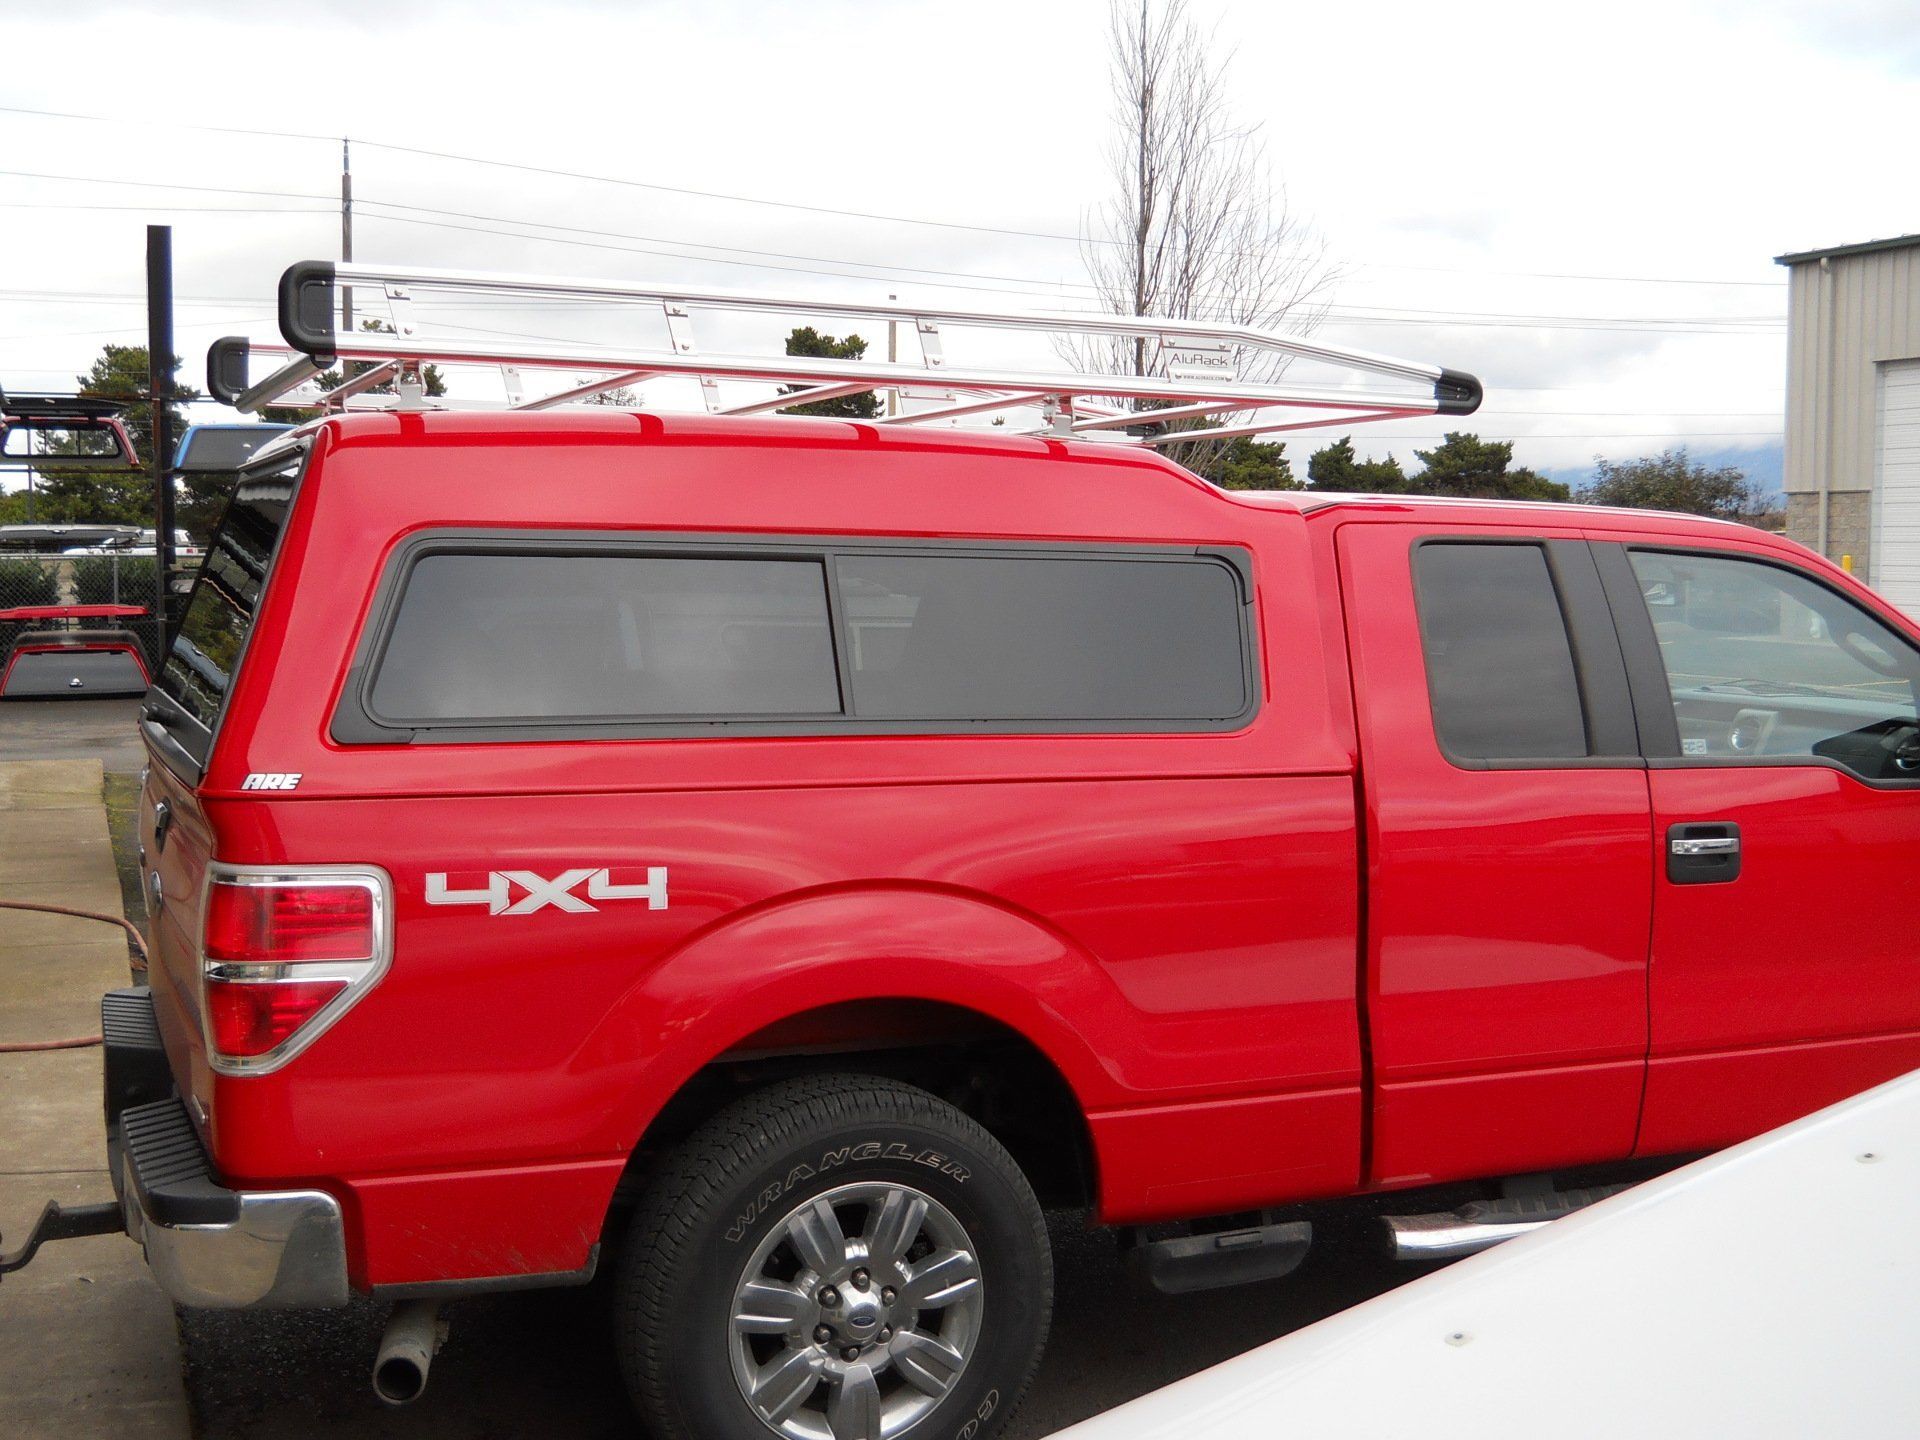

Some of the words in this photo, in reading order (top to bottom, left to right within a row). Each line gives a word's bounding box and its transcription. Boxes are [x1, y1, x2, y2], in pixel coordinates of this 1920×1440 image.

[1169, 353, 1228, 366] AluRack
[240, 772, 303, 791] ARE
[725, 1142, 972, 1242] WRANGLER
